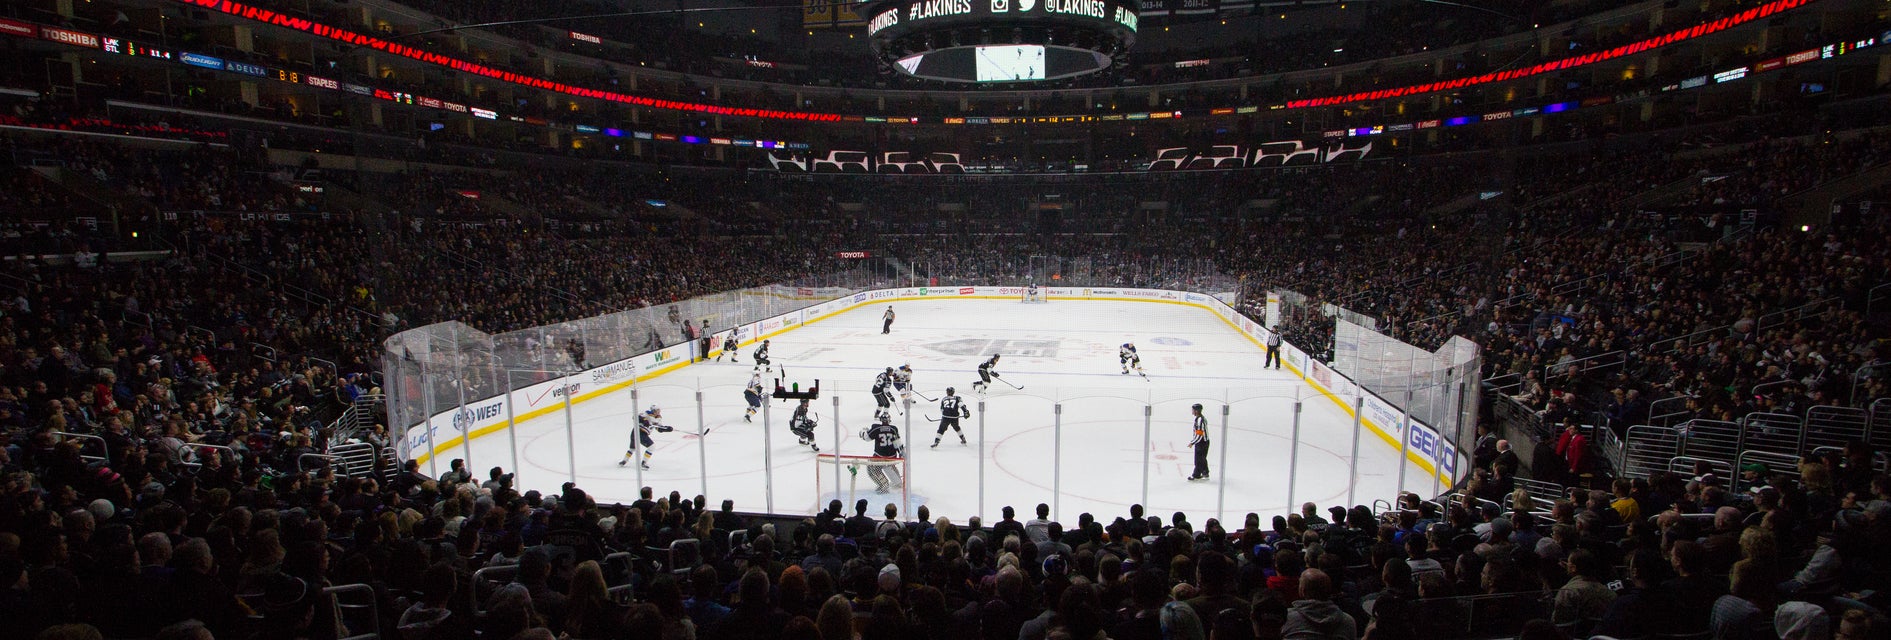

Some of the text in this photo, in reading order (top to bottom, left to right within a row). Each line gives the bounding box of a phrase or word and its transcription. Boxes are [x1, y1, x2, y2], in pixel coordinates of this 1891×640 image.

[909, 0, 971, 20] #LAKINGS
[1044, 0, 1105, 18] @LAKINGS
[0, 23, 31, 33] cDonald's
[42, 28, 98, 47] TOSHIBA
[103, 37, 119, 46] LAK
[572, 31, 601, 43] TOSHIBA
[104, 45, 120, 53] STL
[150, 49, 170, 59] 11.4
[1786, 50, 1819, 64] TOSHIBA
[236, 63, 265, 75] DELTA
[308, 76, 338, 90] STAPLES
[443, 101, 467, 113] TOYOTA
[1483, 112, 1512, 121] TOYOTA
[258, 213, 291, 222] KIGS
[840, 251, 865, 259] TOYOTA
[875, 290, 894, 298] DELTA
[654, 350, 670, 362] WM
[592, 369, 607, 382] SAN
[610, 359, 635, 375] MANUEL
[942, 399, 957, 409] 27
[476, 402, 503, 421] WEST
[1410, 424, 1455, 474] GEICO
